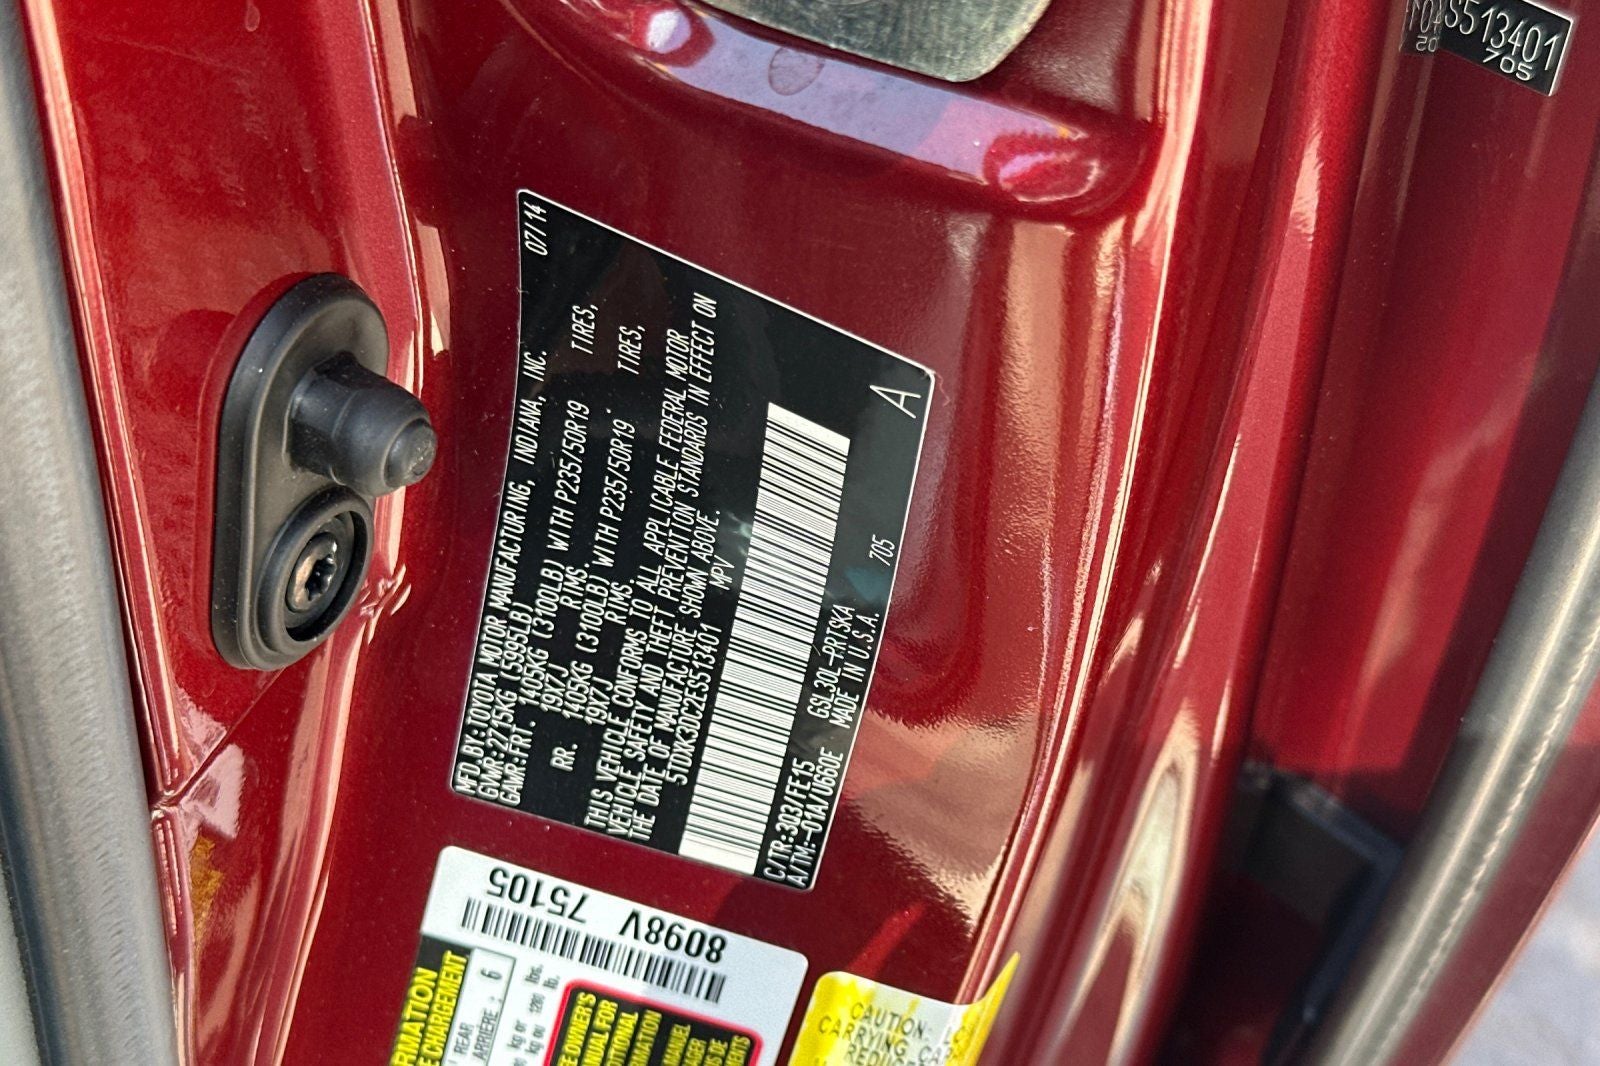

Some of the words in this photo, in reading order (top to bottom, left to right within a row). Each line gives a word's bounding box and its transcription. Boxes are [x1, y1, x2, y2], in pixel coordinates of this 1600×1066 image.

[1482, 47, 1533, 81] 705
[524, 202, 548, 255] 07/14
[571, 305, 598, 354] TIRES,
[693, 292, 717, 318] ON
[523, 351, 547, 381] INC.
[618, 326, 645, 374] TIRES,
[665, 329, 692, 381] MOTOR
[689, 320, 714, 382] EFFECT
[659, 388, 690, 452] FEDERAL
[688, 383, 710, 406] IN
[870, 385, 921, 419] A
[514, 396, 546, 464] INDIANA,
[554, 400, 589, 504] P235/50R19
[677, 412, 708, 497] STANDARDS
[600, 419, 635, 521] P235/50R19
[547, 506, 574, 551] WITH
[643, 454, 679, 556] APPLICABLE
[488, 480, 535, 613] MANUFACTURING,
[592, 523, 619, 567] WITH
[658, 501, 697, 601] PREVENTION
[691, 510, 720, 563] ABOVE.
[868, 534, 895, 566] 705
[528, 559, 567, 638] (3100LB)
[636, 565, 663, 594] ALL
[679, 566, 709, 618] SHOWN
[575, 575, 612, 653] (3100LB)
[629, 599, 653, 619] TO
[646, 605, 675, 656] THEFT
[478, 615, 508, 668] MOTOR
[540, 663, 569, 713] 19X7J
[559, 563, 589, 610] RIMS.
[585, 677, 613, 725] 19X7J
[604, 579, 634, 625] RIMS.
[848, 613, 879, 659] U.S.A.
[518, 647, 549, 707] 1405KG
[562, 661, 594, 721] 1405KG
[612, 628, 647, 707] CONFORMS
[639, 664, 664, 697] AND
[654, 623, 699, 732] MANUFACTURE
[664, 623, 721, 785] 5TDXK3DC2ES513401
[709, 555, 735, 590] MPV
[842, 662, 866, 682] IN
[477, 689, 519, 799] GVWR:2715KG
[500, 602, 536, 684] (5995LB)
[829, 687, 859, 729] MADE
[550, 744, 577, 771] RR.
[596, 712, 631, 781] VEHICLE
[623, 700, 655, 764] SAFETY
[648, 735, 671, 761] OF
[498, 721, 536, 805] GAWR:FRT.
[636, 763, 667, 806] DATE
[584, 789, 613, 827] THIS
[607, 764, 644, 837] VEHICLE
[628, 810, 655, 840] THE
[487, 867, 588, 924] 75105
[618, 908, 727, 964] 8098V
[420, 950, 467, 1060] CHARGEMENT
[562, 992, 596, 1057] OWNER'S
[592, 1000, 618, 1032] FOR
[819, 1016, 908, 1057] CARRYING
